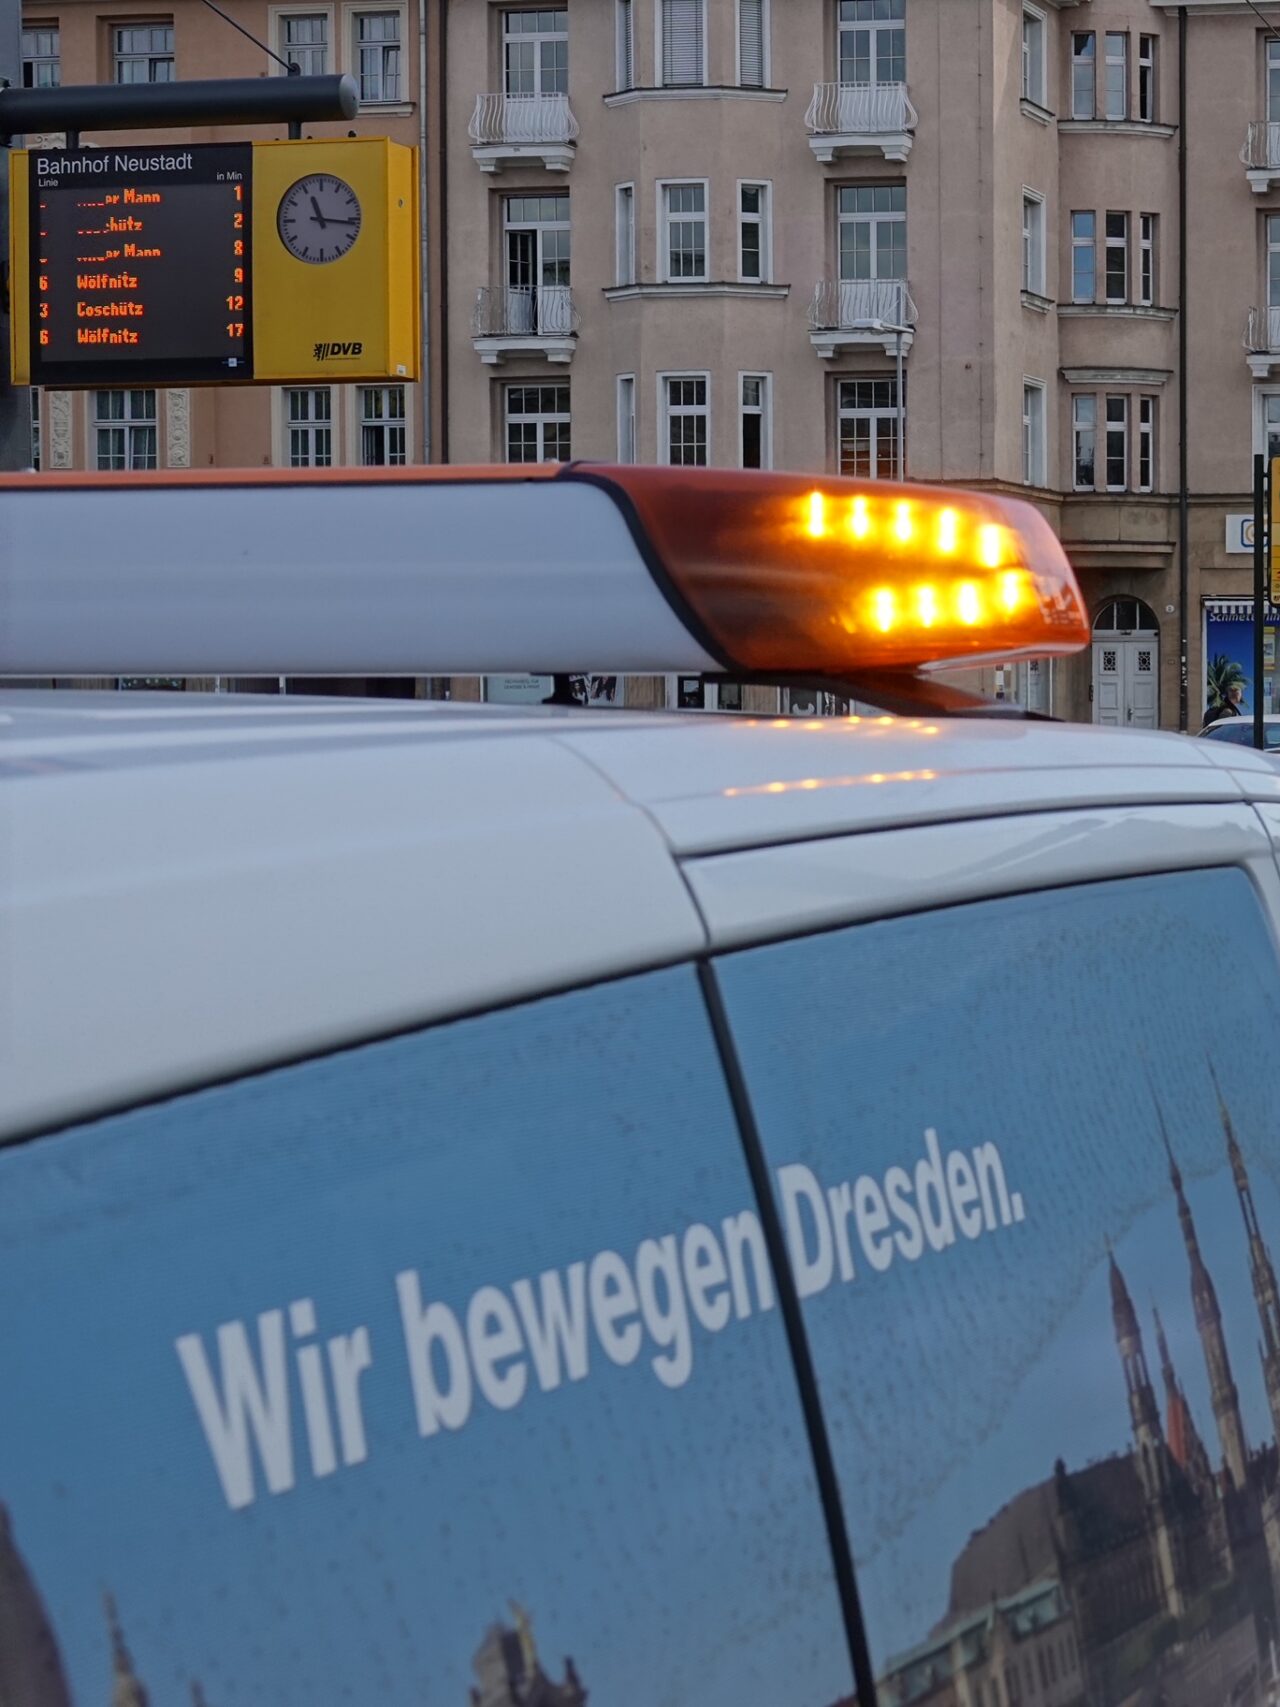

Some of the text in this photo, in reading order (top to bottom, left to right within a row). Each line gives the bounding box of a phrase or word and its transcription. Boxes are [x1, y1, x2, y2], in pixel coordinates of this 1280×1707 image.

[37, 153, 193, 175] Bahnhof Neustadt
[38, 178, 59, 187] Linie
[216, 171, 243, 181] in Min
[123, 188, 161, 204] Mann
[233, 184, 243, 201] 1
[233, 212, 244, 228] 2
[233, 239, 244, 256] 8
[39, 275, 48, 290] 6
[234, 267, 244, 284] 9
[39, 295, 244, 318] 3 Coschütz 12
[39, 323, 244, 345] 6 Wölfnitz 17
[330, 342, 363, 356] DVB
[176, 1126, 1025, 1511] Wir bewegen Dresden.
